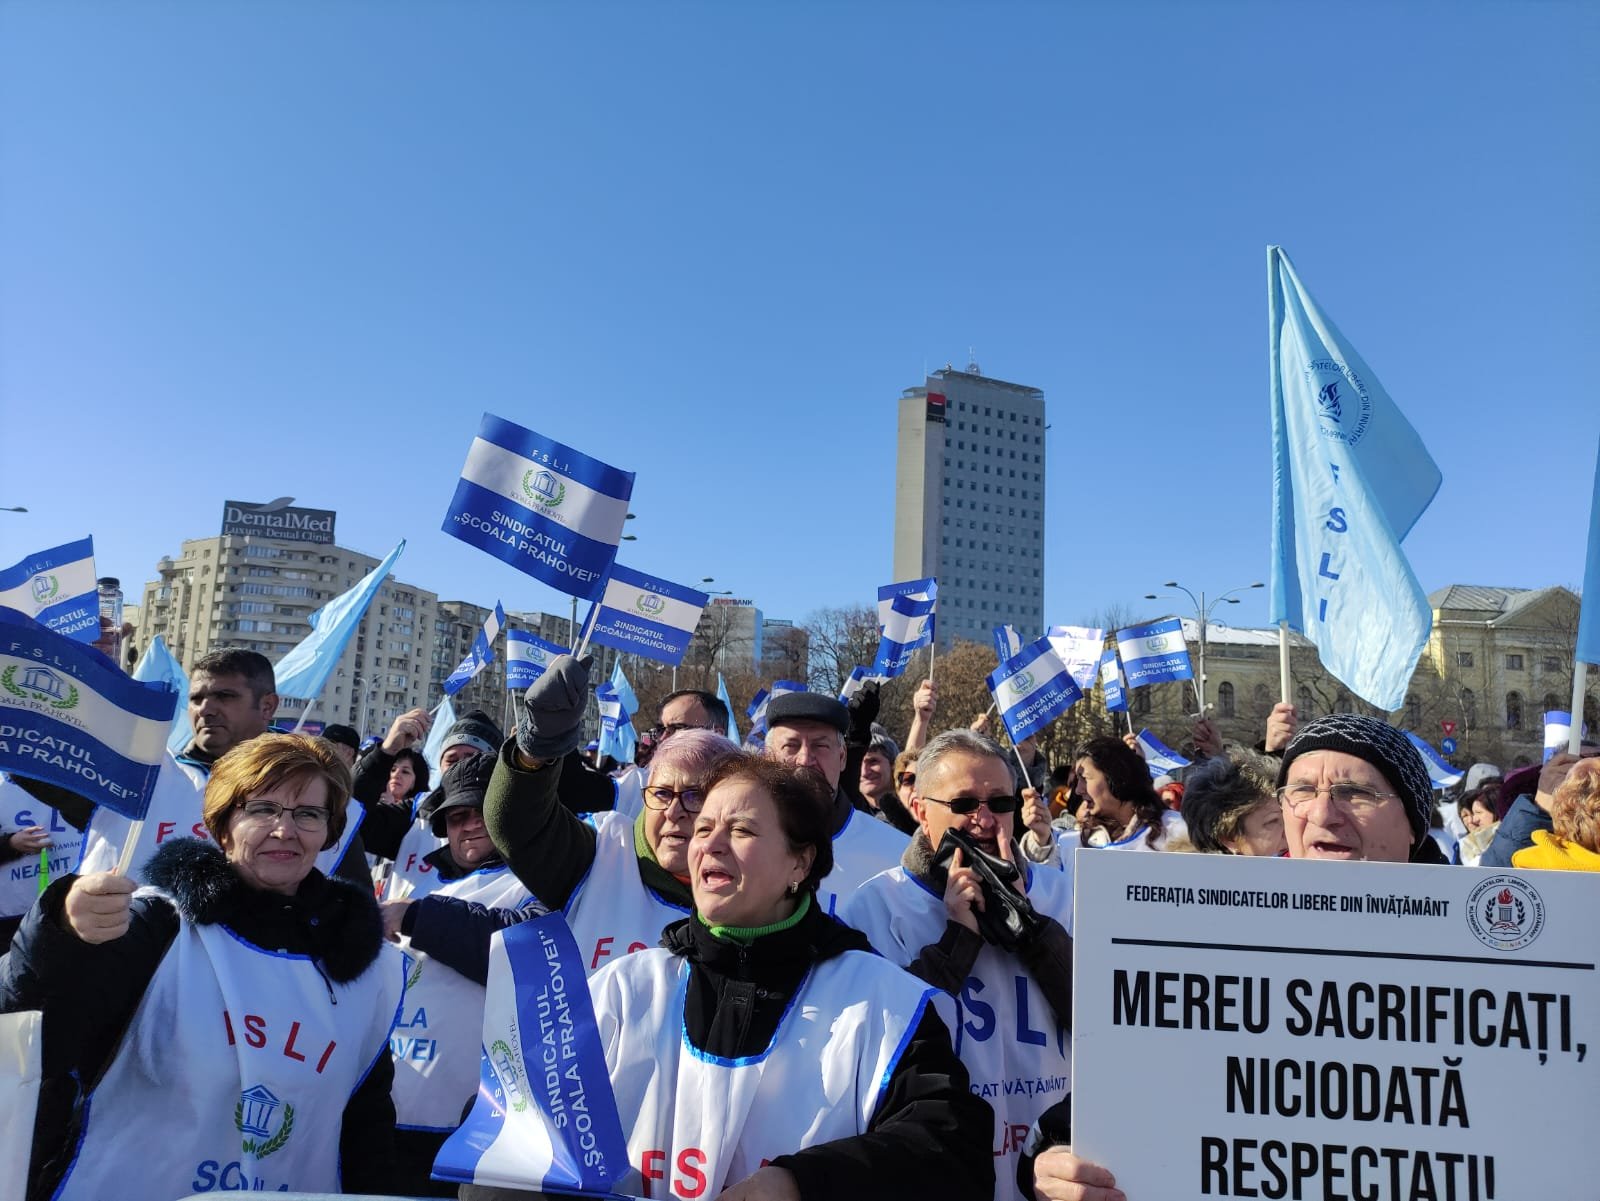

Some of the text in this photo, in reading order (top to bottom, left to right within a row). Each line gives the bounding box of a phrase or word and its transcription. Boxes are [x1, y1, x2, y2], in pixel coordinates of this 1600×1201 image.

[224, 523, 332, 543] Luxury Dental Clinic
[225, 506, 332, 533] DentalMed
[491, 510, 568, 557] SINDICATUL
[518, 540, 600, 583] PRAHOVEI”
[614, 620, 665, 641] SINDICATUL
[10, 642, 83, 678] F.S.L.I.
[1016, 688, 1058, 720] SINDICATUL
[17, 743, 138, 799] PRAHOVEI”
[1127, 884, 1450, 919] FEDERAȚIA SINDICATELOR LIBERE DIN ÎNVĂȚĂMÂNT
[1113, 969, 1587, 1066] MEREU SACRIFICAȚI,
[536, 984, 568, 1129] SINDICATUL
[1226, 1055, 1470, 1129] NICIODATĂ
